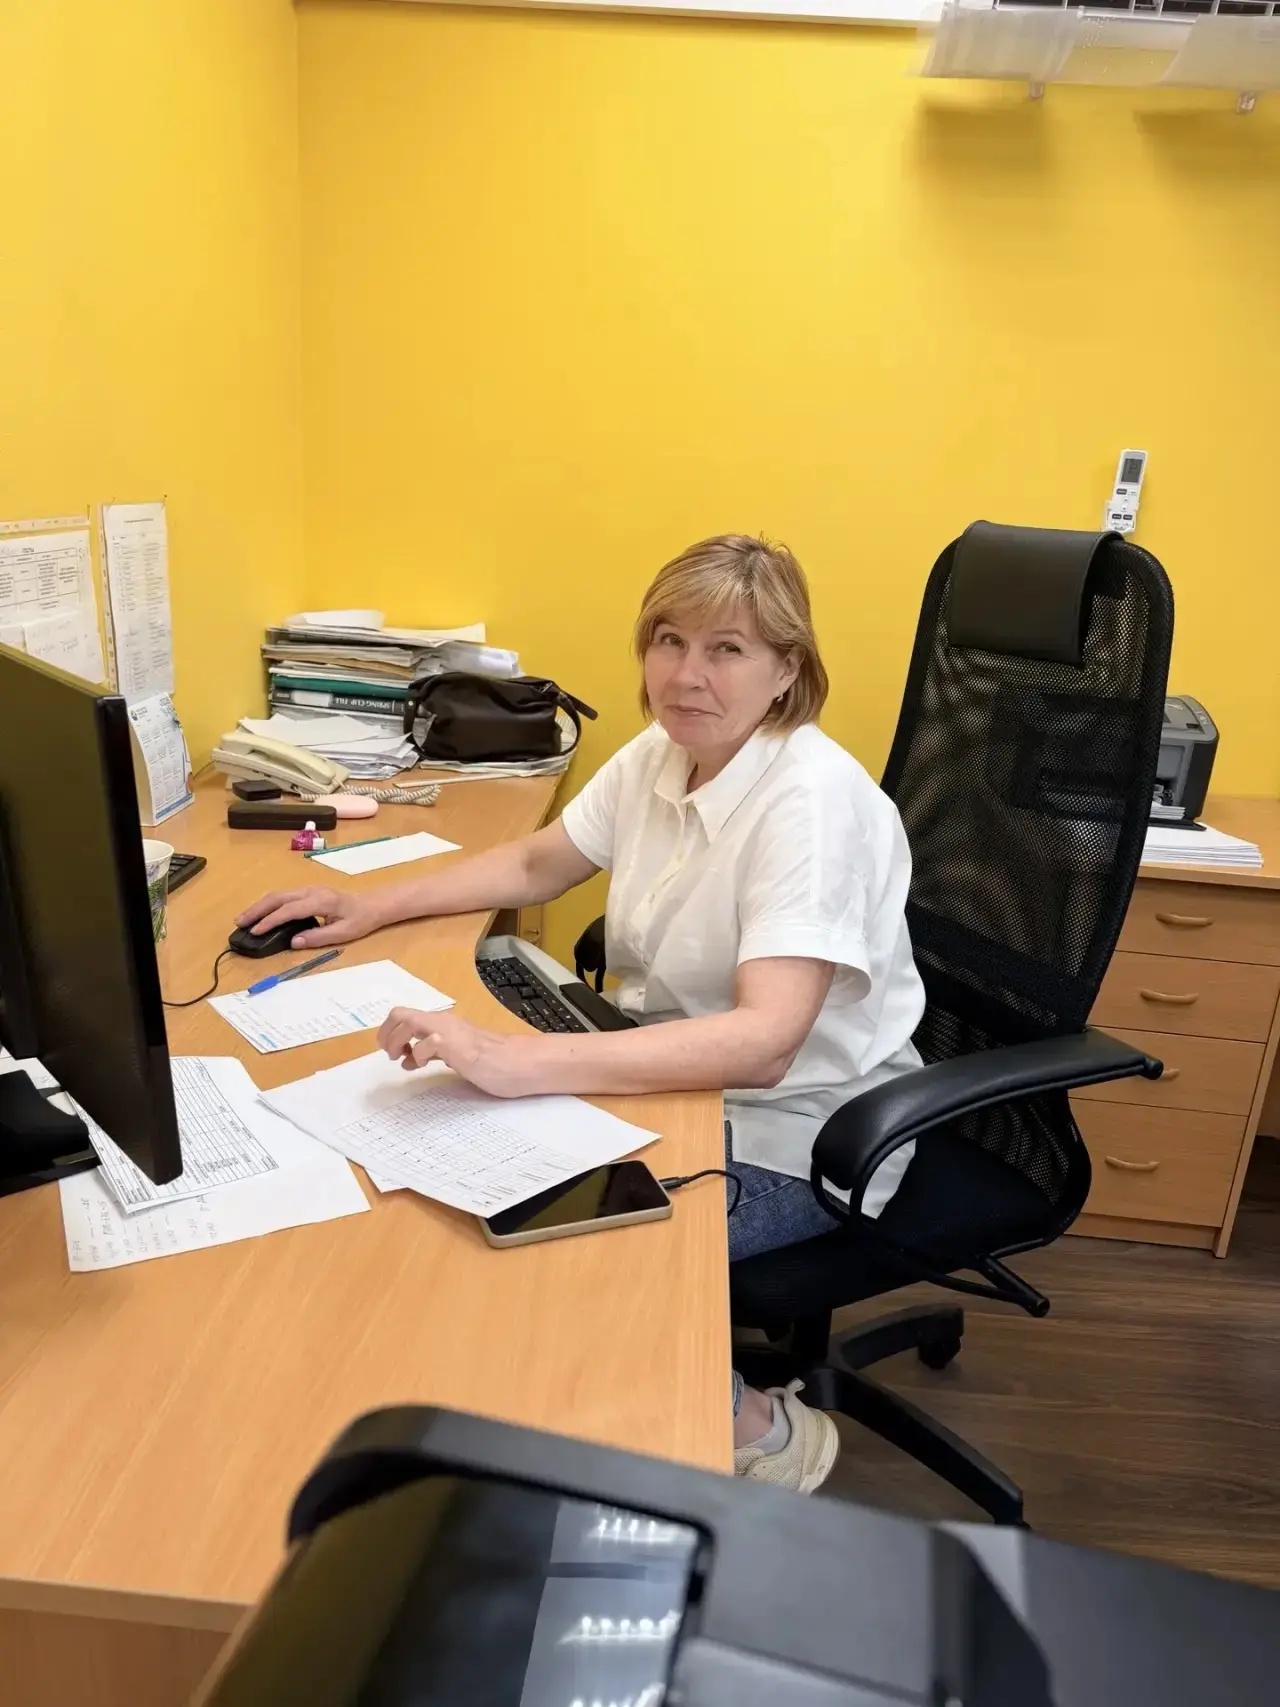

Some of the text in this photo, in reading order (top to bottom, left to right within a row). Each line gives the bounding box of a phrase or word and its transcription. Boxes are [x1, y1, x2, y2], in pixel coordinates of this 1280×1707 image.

[335, 697, 390, 709] SPRING CLIP FILE
